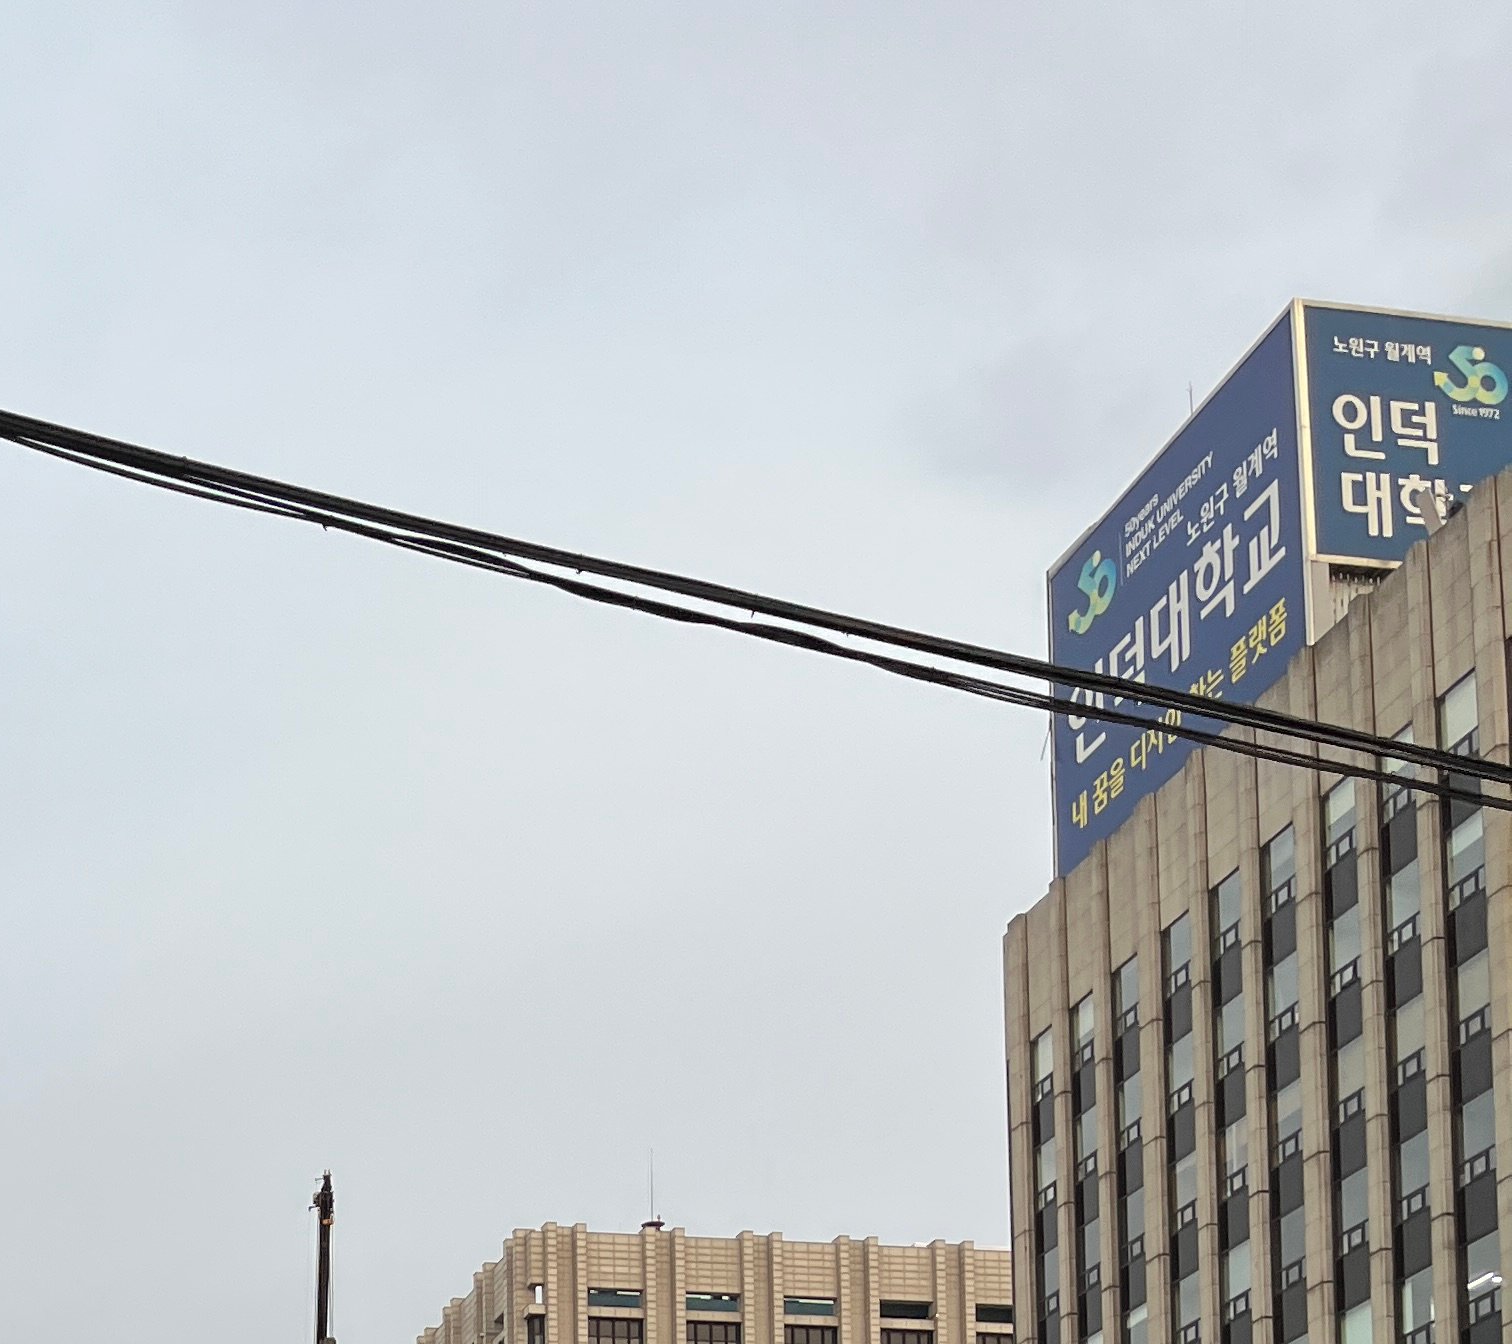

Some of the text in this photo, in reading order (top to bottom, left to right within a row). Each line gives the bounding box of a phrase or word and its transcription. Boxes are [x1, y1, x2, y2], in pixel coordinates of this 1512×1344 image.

[1333, 336, 1432, 366] 노원구 월계역
[1331, 394, 1440, 466] 인덕
[1452, 403, 1501, 420] Since 1972
[1124, 450, 1214, 558] INDUK UNIVERSITY
[1185, 427, 1278, 547] 노원구 월계역
[1340, 471, 1475, 538] 대학
[1125, 508, 1185, 579] NEXT LEVEL
[1067, 477, 1287, 765] 인덕대학교
[1071, 789, 1088, 829] 내
[1092, 757, 1126, 816] 꿈을
[1228, 597, 1288, 684] 플랫폼
